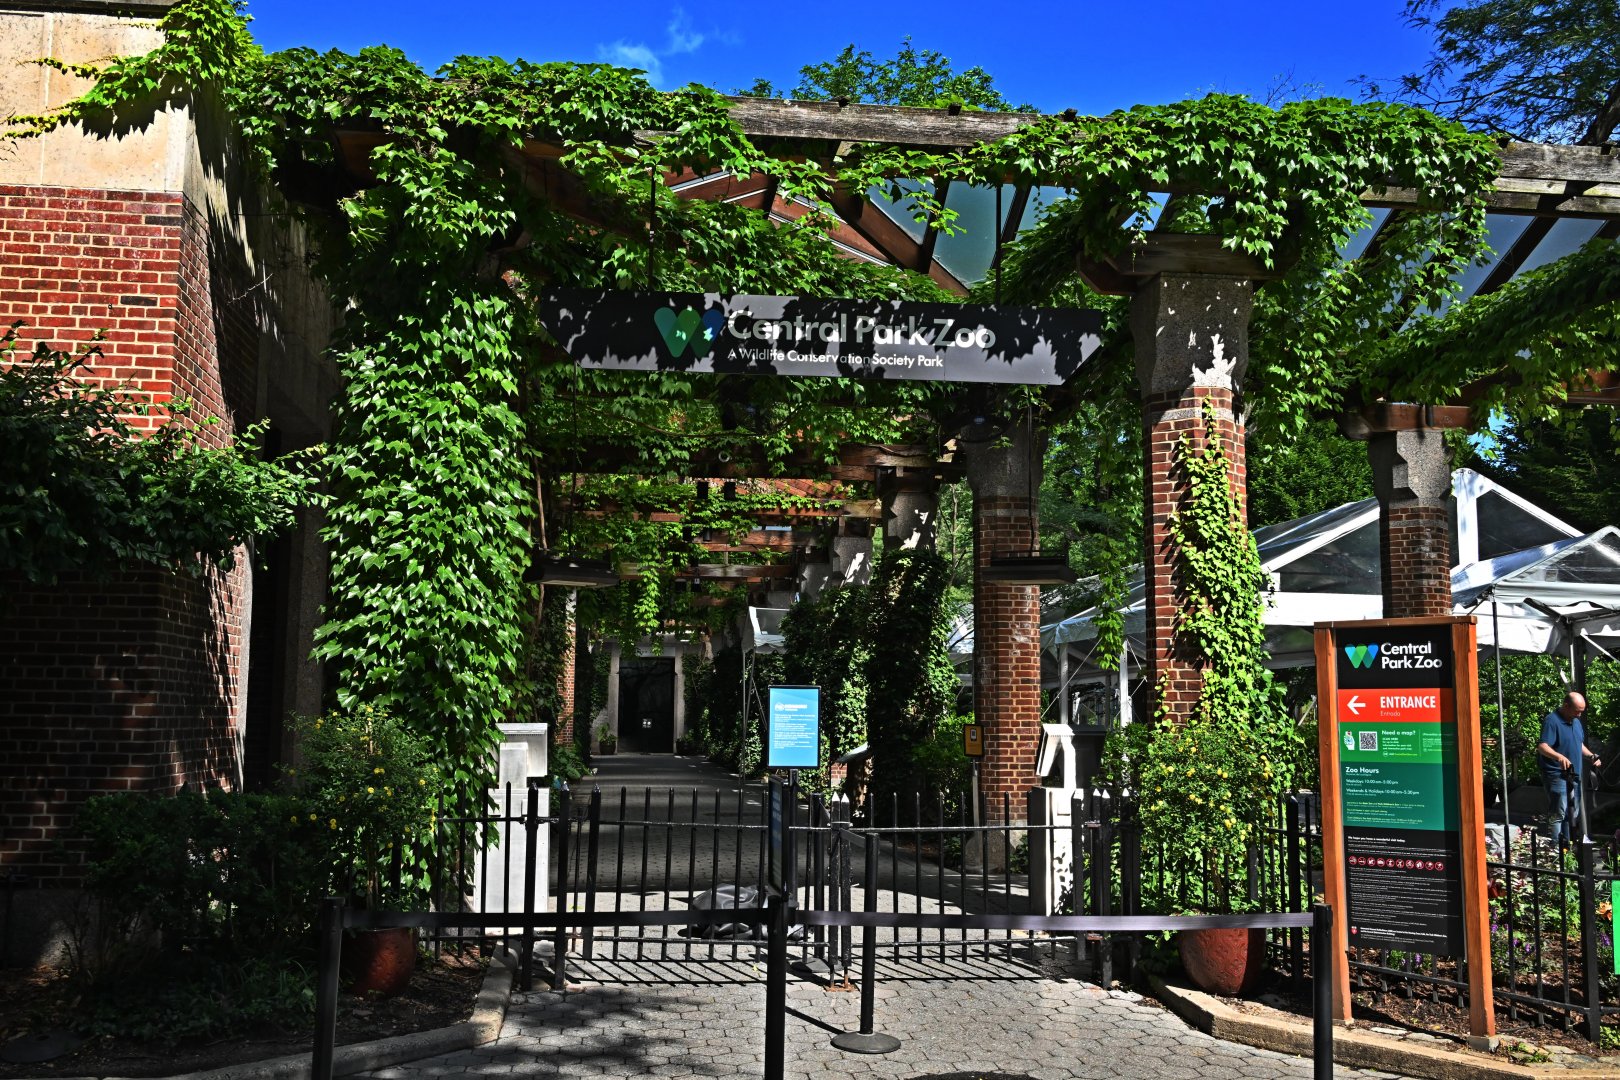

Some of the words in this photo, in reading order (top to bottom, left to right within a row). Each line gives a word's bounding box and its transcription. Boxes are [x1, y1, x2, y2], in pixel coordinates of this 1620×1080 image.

[728, 309, 847, 343] Central
[856, 315, 928, 346] Park
[933, 318, 996, 349] Zoo
[727, 348, 737, 359] A
[739, 348, 785, 361] Wildlife
[787, 349, 870, 364] Conservation
[872, 352, 915, 368] Society
[917, 354, 943, 367] Park
[1381, 641, 1432, 655] Central
[1381, 655, 1412, 669] Park
[1414, 655, 1443, 669] Zoo
[1380, 695, 1437, 709] ENTRANCE
